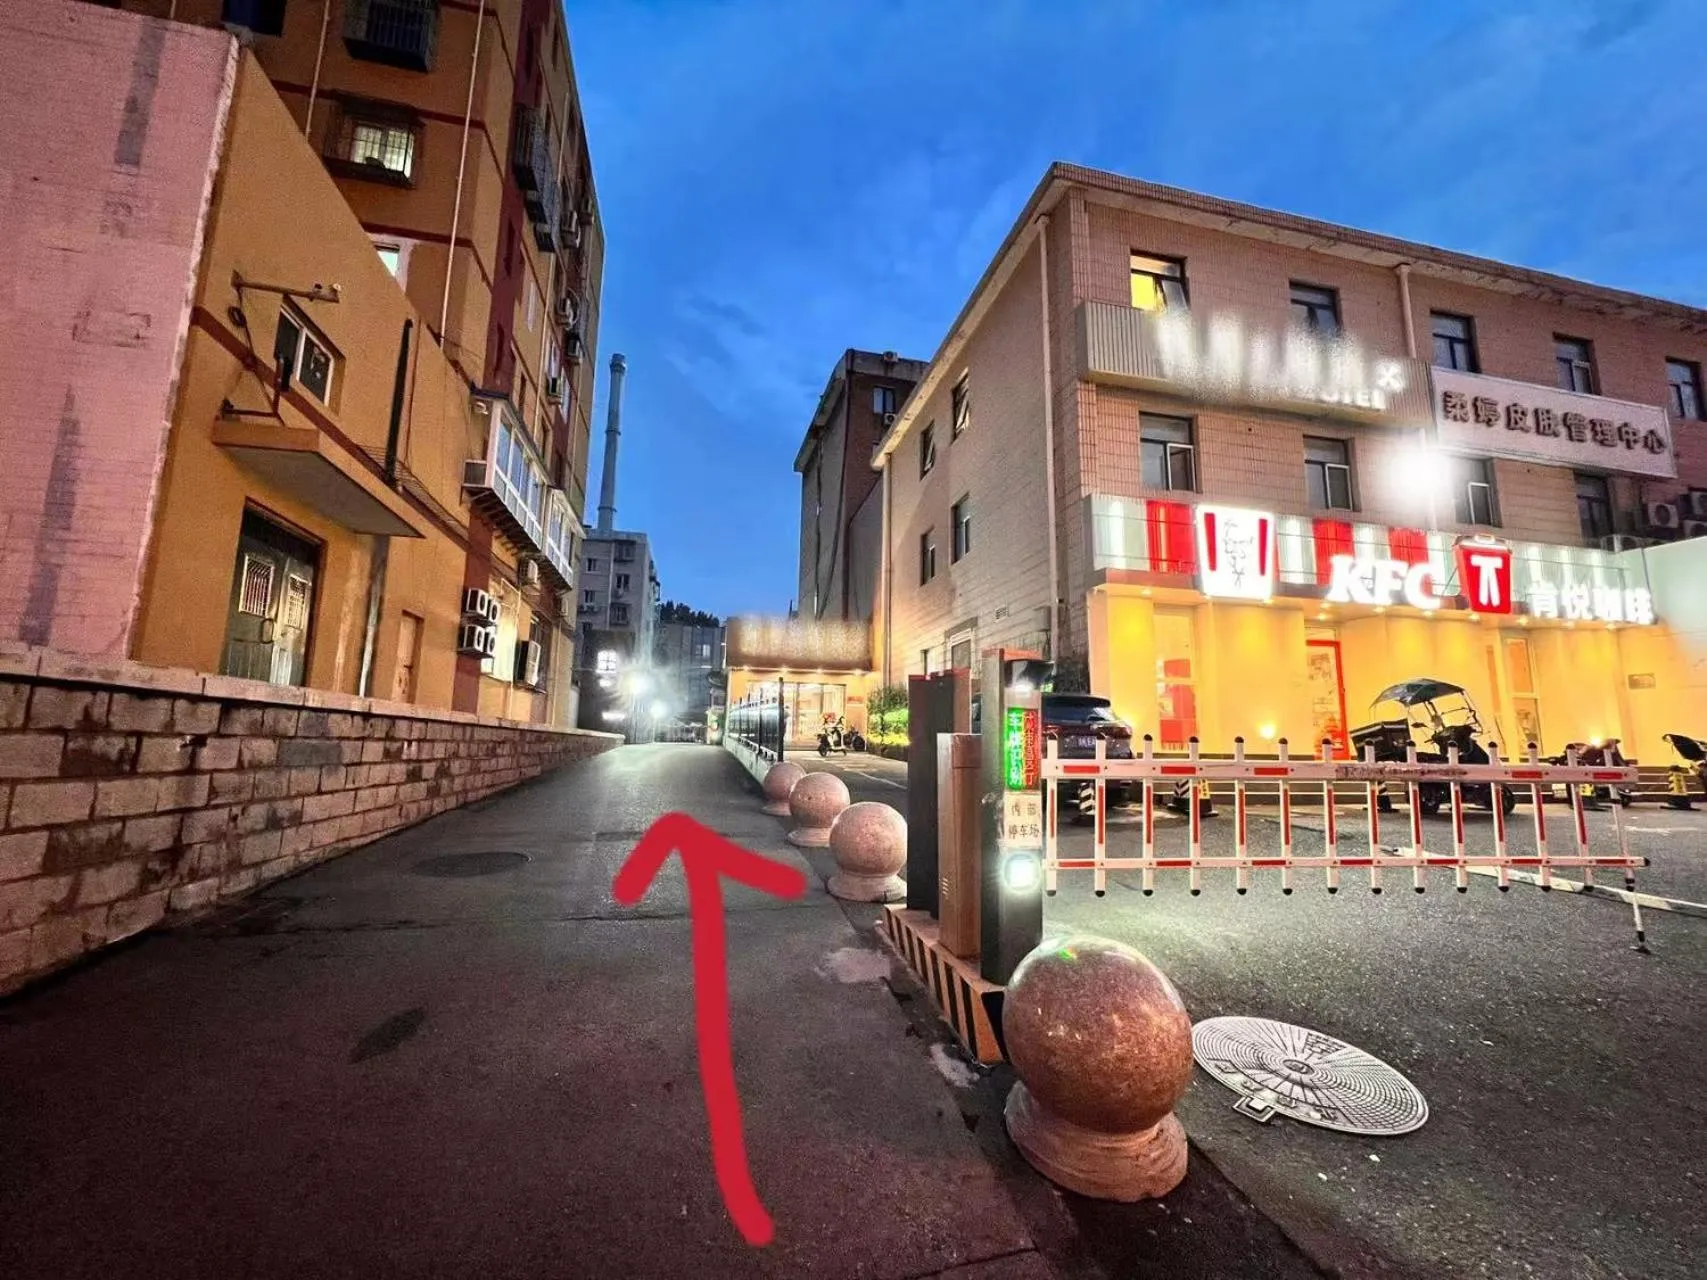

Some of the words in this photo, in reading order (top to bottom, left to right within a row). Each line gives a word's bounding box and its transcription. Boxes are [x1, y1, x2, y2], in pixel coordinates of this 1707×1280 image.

[1443, 389, 1667, 454] 柔婷皮肤管理中心
[1327, 554, 1441, 609] KFC
[1008, 823, 1040, 840] 停车场
